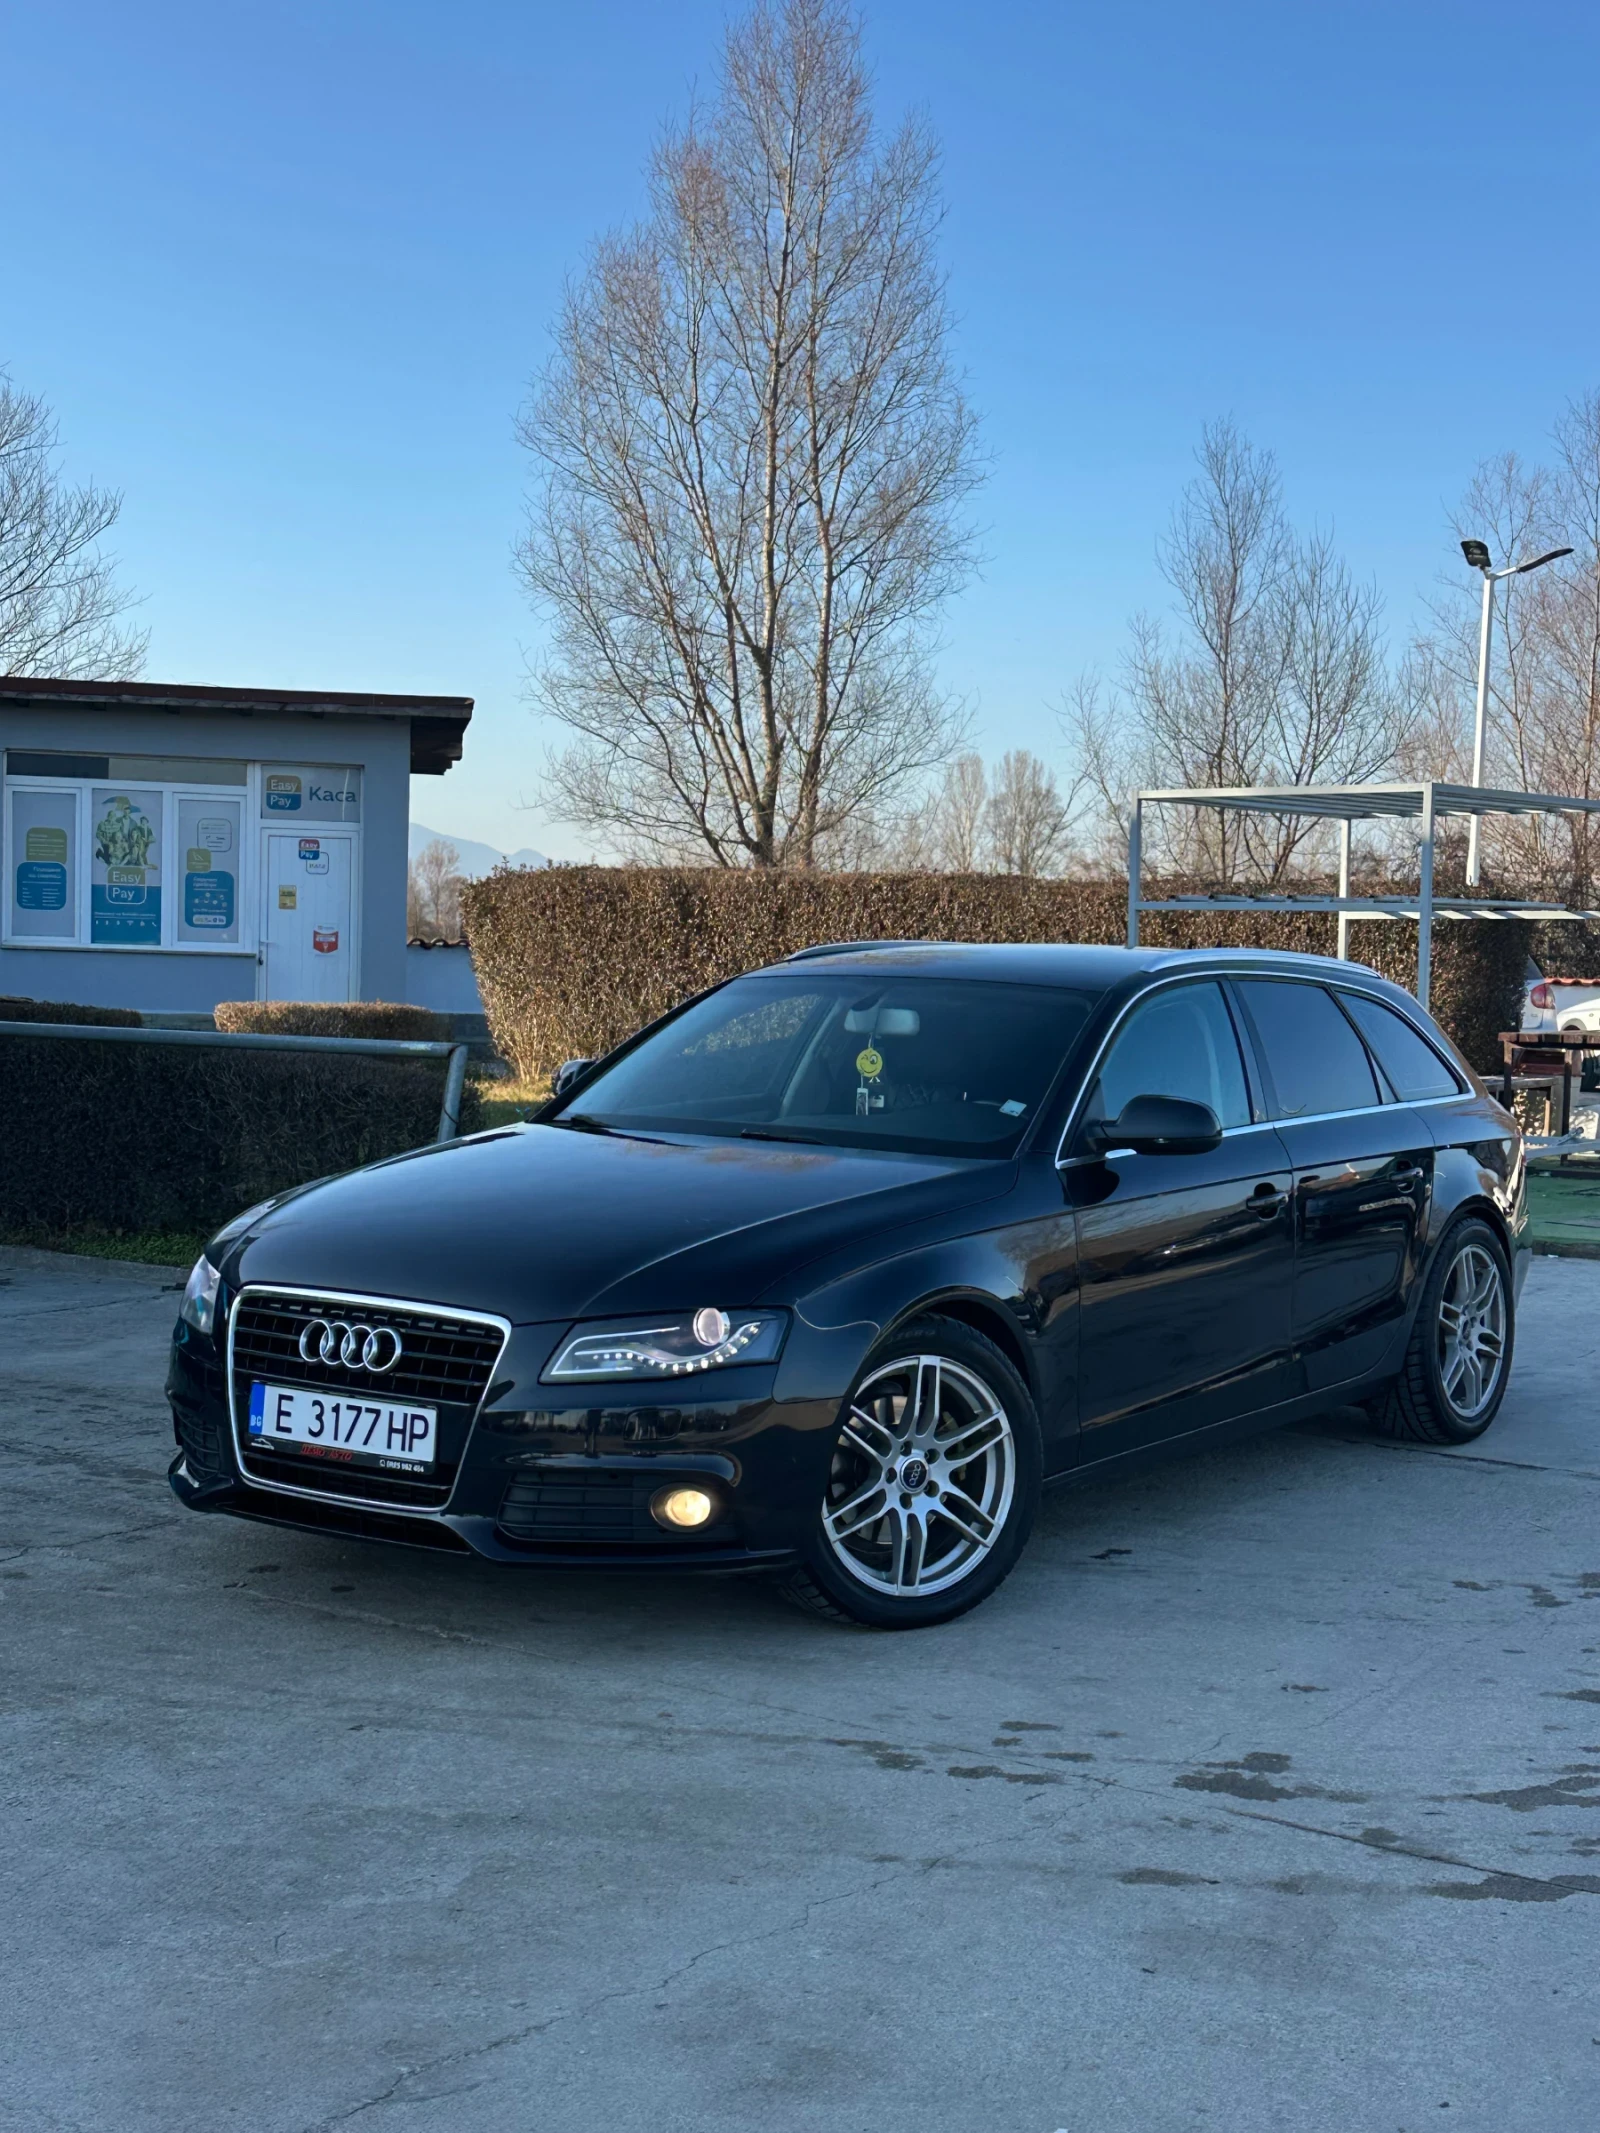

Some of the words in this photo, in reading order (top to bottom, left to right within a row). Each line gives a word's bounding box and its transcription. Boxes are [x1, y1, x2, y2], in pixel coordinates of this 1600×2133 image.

[270, 779, 298, 793] Easy
[270, 795, 292, 808] Pay
[309, 786, 357, 803] Каса
[300, 841, 318, 850] Easy
[300, 851, 314, 859] Pay
[112, 871, 141, 885] Easy
[112, 887, 135, 901] Pay
[250, 1414, 262, 1427] BG
[276, 1393, 294, 1434] E
[308, 1399, 382, 1447] 3177
[386, 1410, 430, 1453] HP
